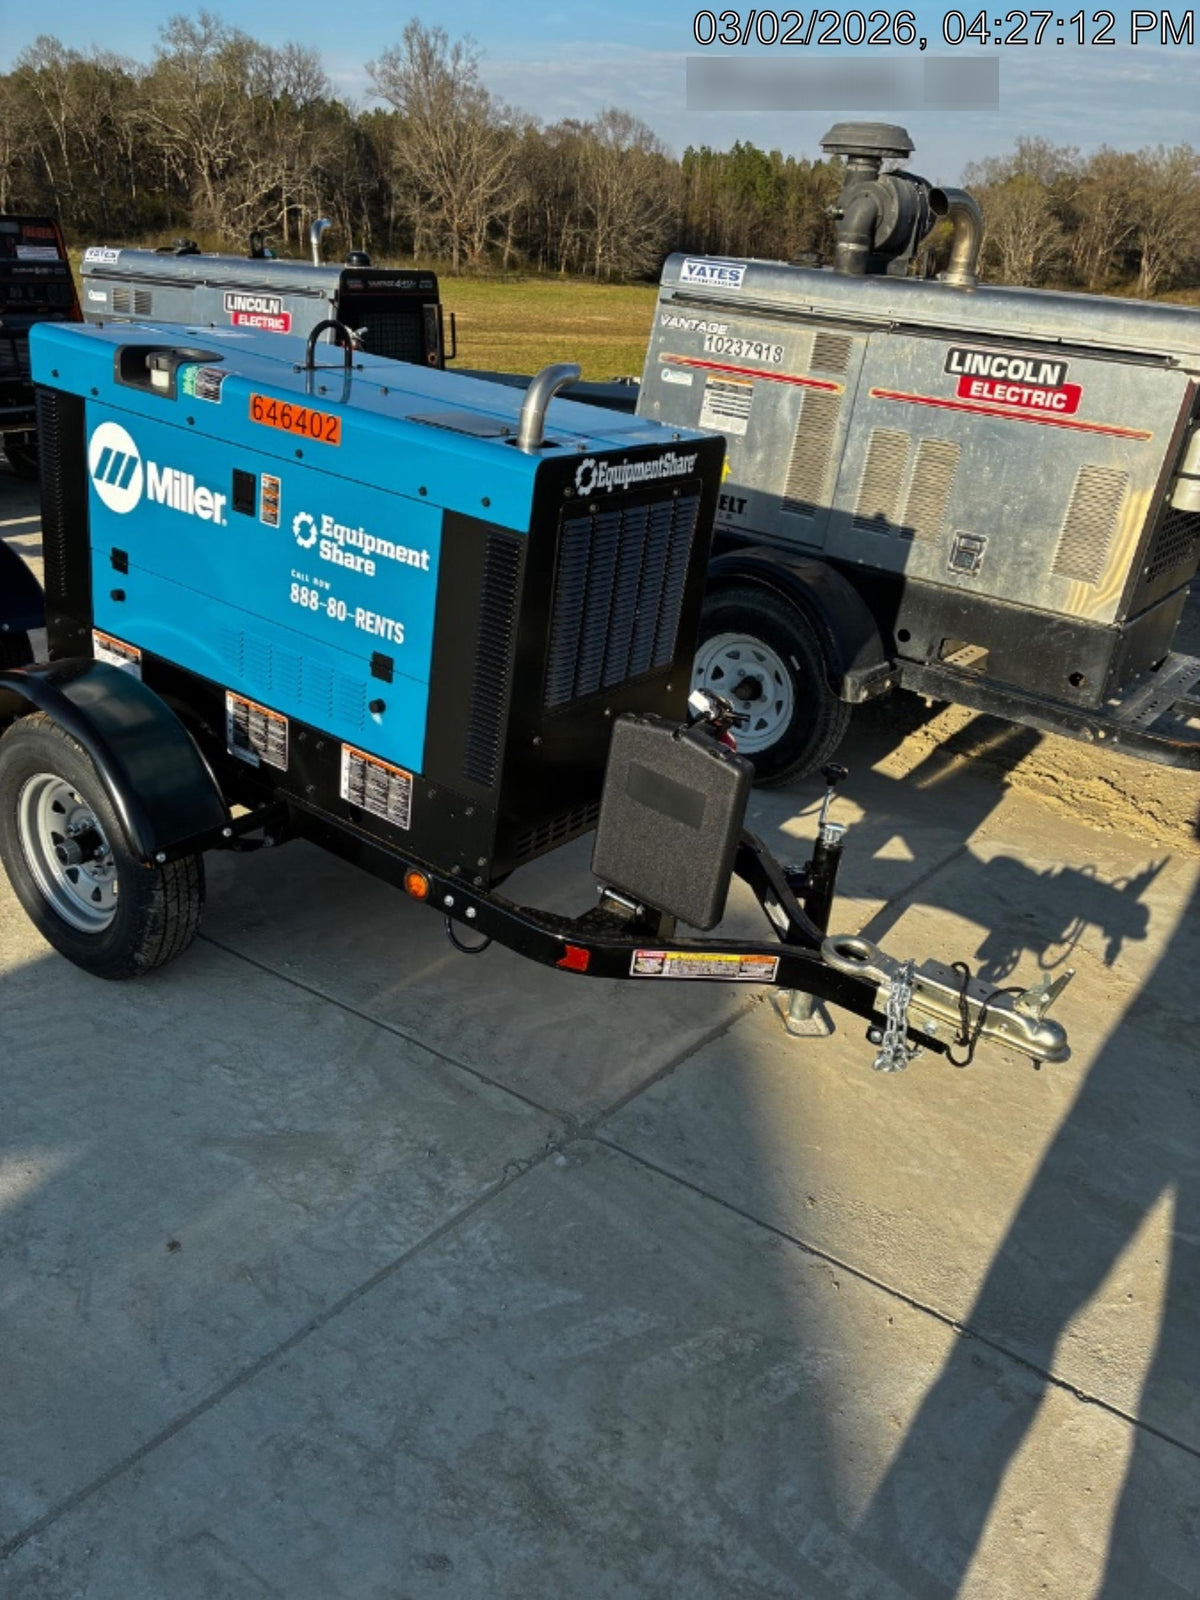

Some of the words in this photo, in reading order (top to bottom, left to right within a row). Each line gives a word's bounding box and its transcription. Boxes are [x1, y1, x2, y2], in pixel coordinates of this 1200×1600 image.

[687, 264, 741, 282] YATES
[227, 295, 281, 315] LINCOLN
[237, 315, 285, 330] ELECTRIC
[660, 314, 730, 335] VANTAGE
[706, 335, 784, 363] 10237918
[950, 351, 1062, 385] LINCOLN
[969, 381, 1068, 410] ELECTRIC
[251, 395, 339, 443] 646402
[596, 452, 697, 493] EquipmentShare
[319, 538, 376, 576] Share
[320, 514, 430, 571] Equipment
[290, 582, 405, 645] 888-80-RENTS
